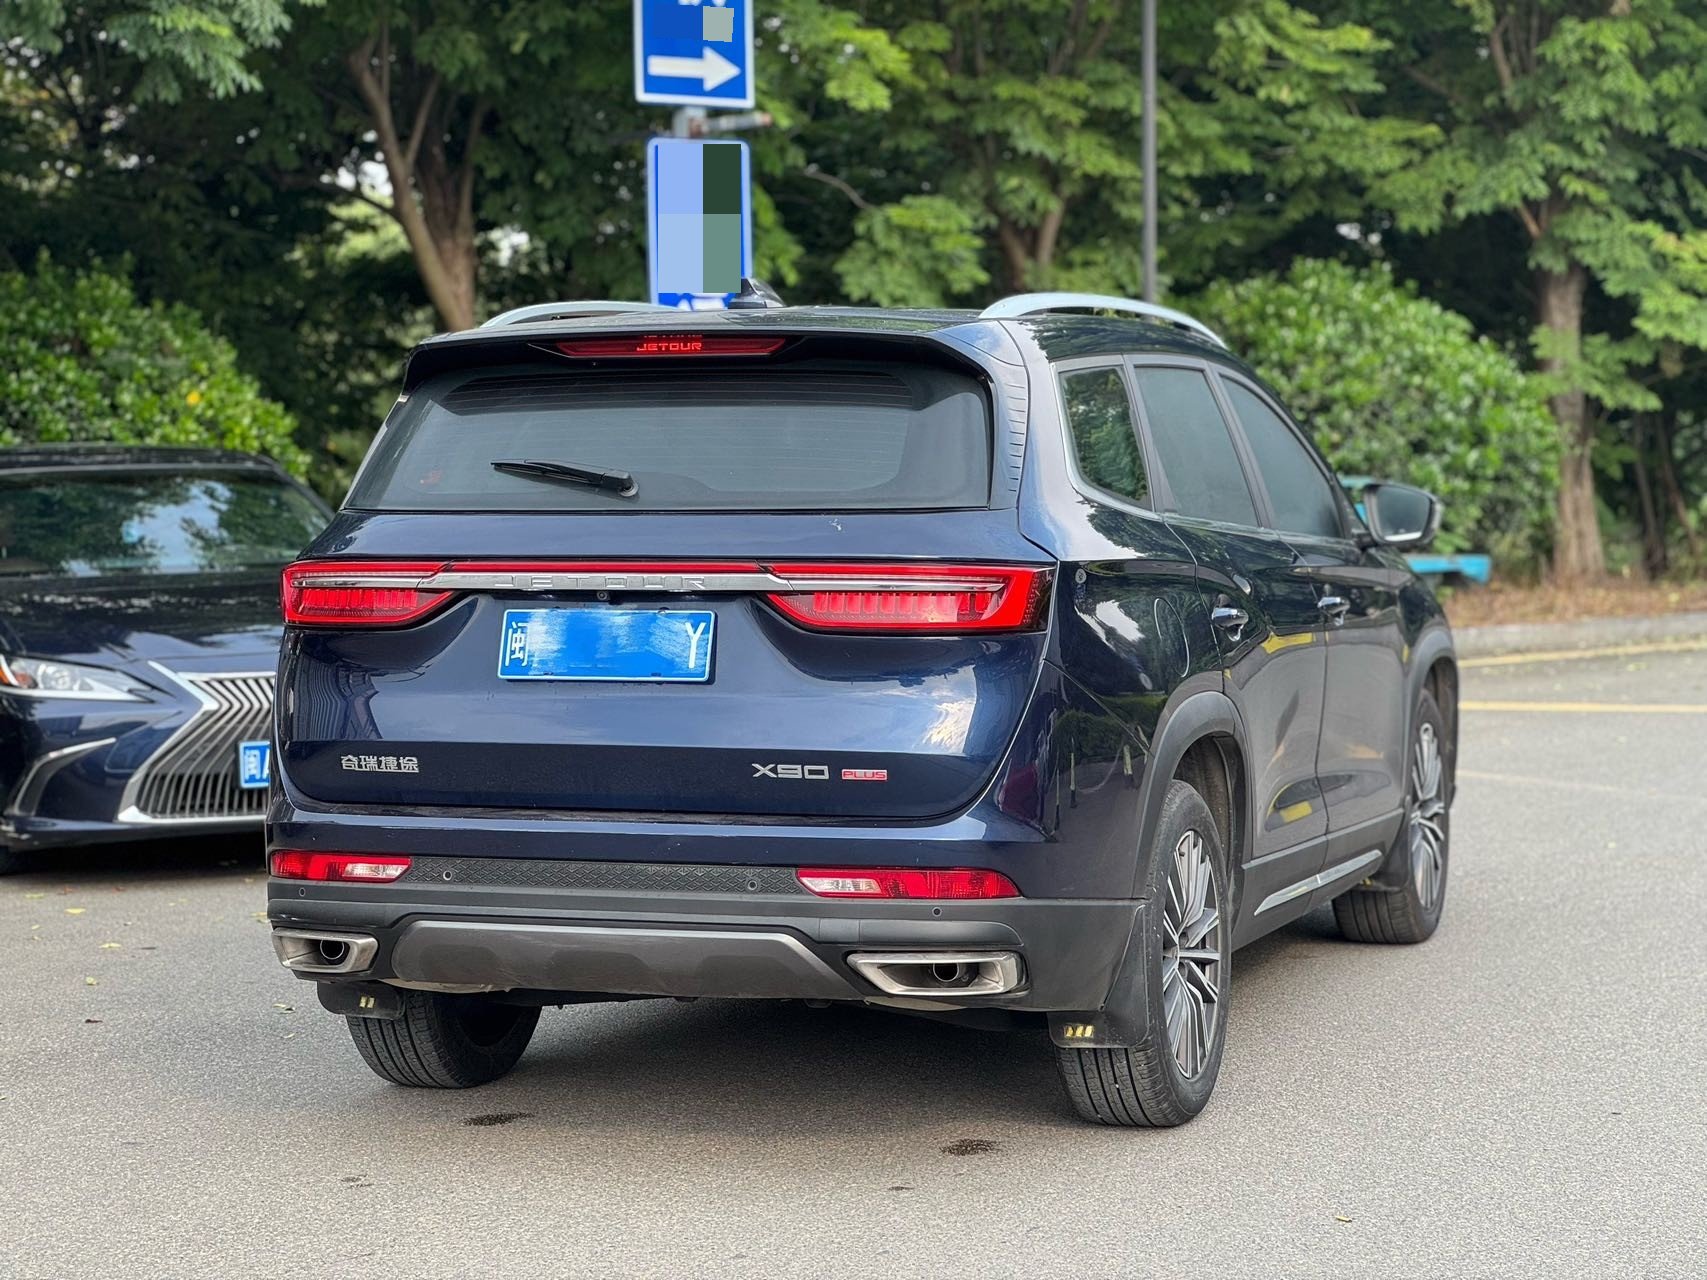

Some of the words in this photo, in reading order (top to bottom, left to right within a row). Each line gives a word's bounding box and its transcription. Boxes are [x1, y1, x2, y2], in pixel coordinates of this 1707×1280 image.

[636, 342, 703, 352] JETOUR
[493, 575, 705, 590] JETOUR
[340, 754, 420, 773] 奇瑞捷途
[751, 763, 830, 780] X90
[842, 770, 887, 781] PLUS
